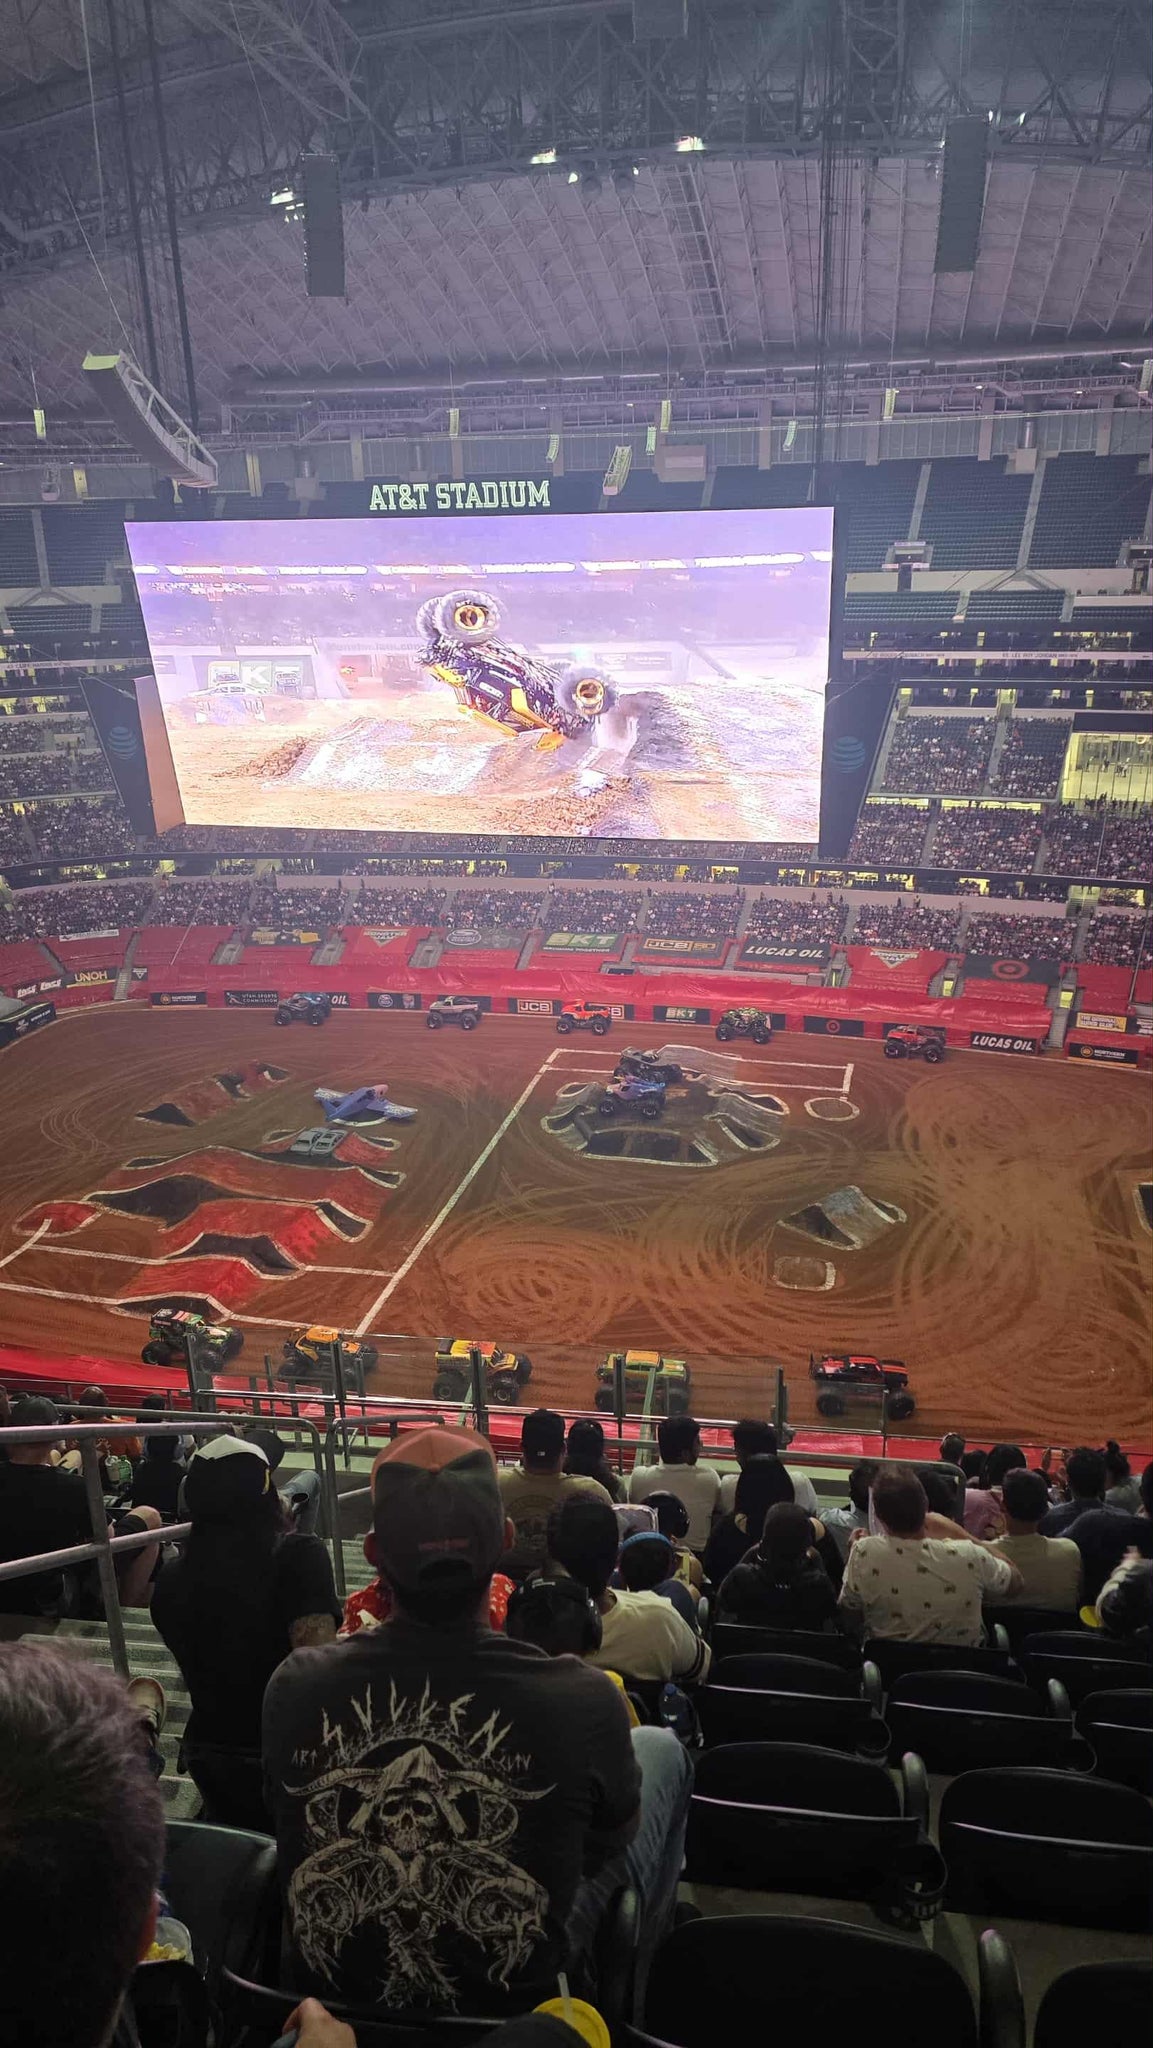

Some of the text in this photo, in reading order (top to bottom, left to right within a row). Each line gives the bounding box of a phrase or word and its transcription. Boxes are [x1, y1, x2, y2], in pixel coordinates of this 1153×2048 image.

[369, 480, 551, 511] AT&T STADIUM
[648, 941, 689, 950] JCB
[745, 946, 825, 959] LUCAS OIL
[74, 970, 108, 982] UNOH
[331, 995, 348, 1005] OIL
[520, 1001, 550, 1012] JCB
[665, 1007, 697, 1018] BKT
[972, 1035, 1033, 1051] LUCAS OIL
